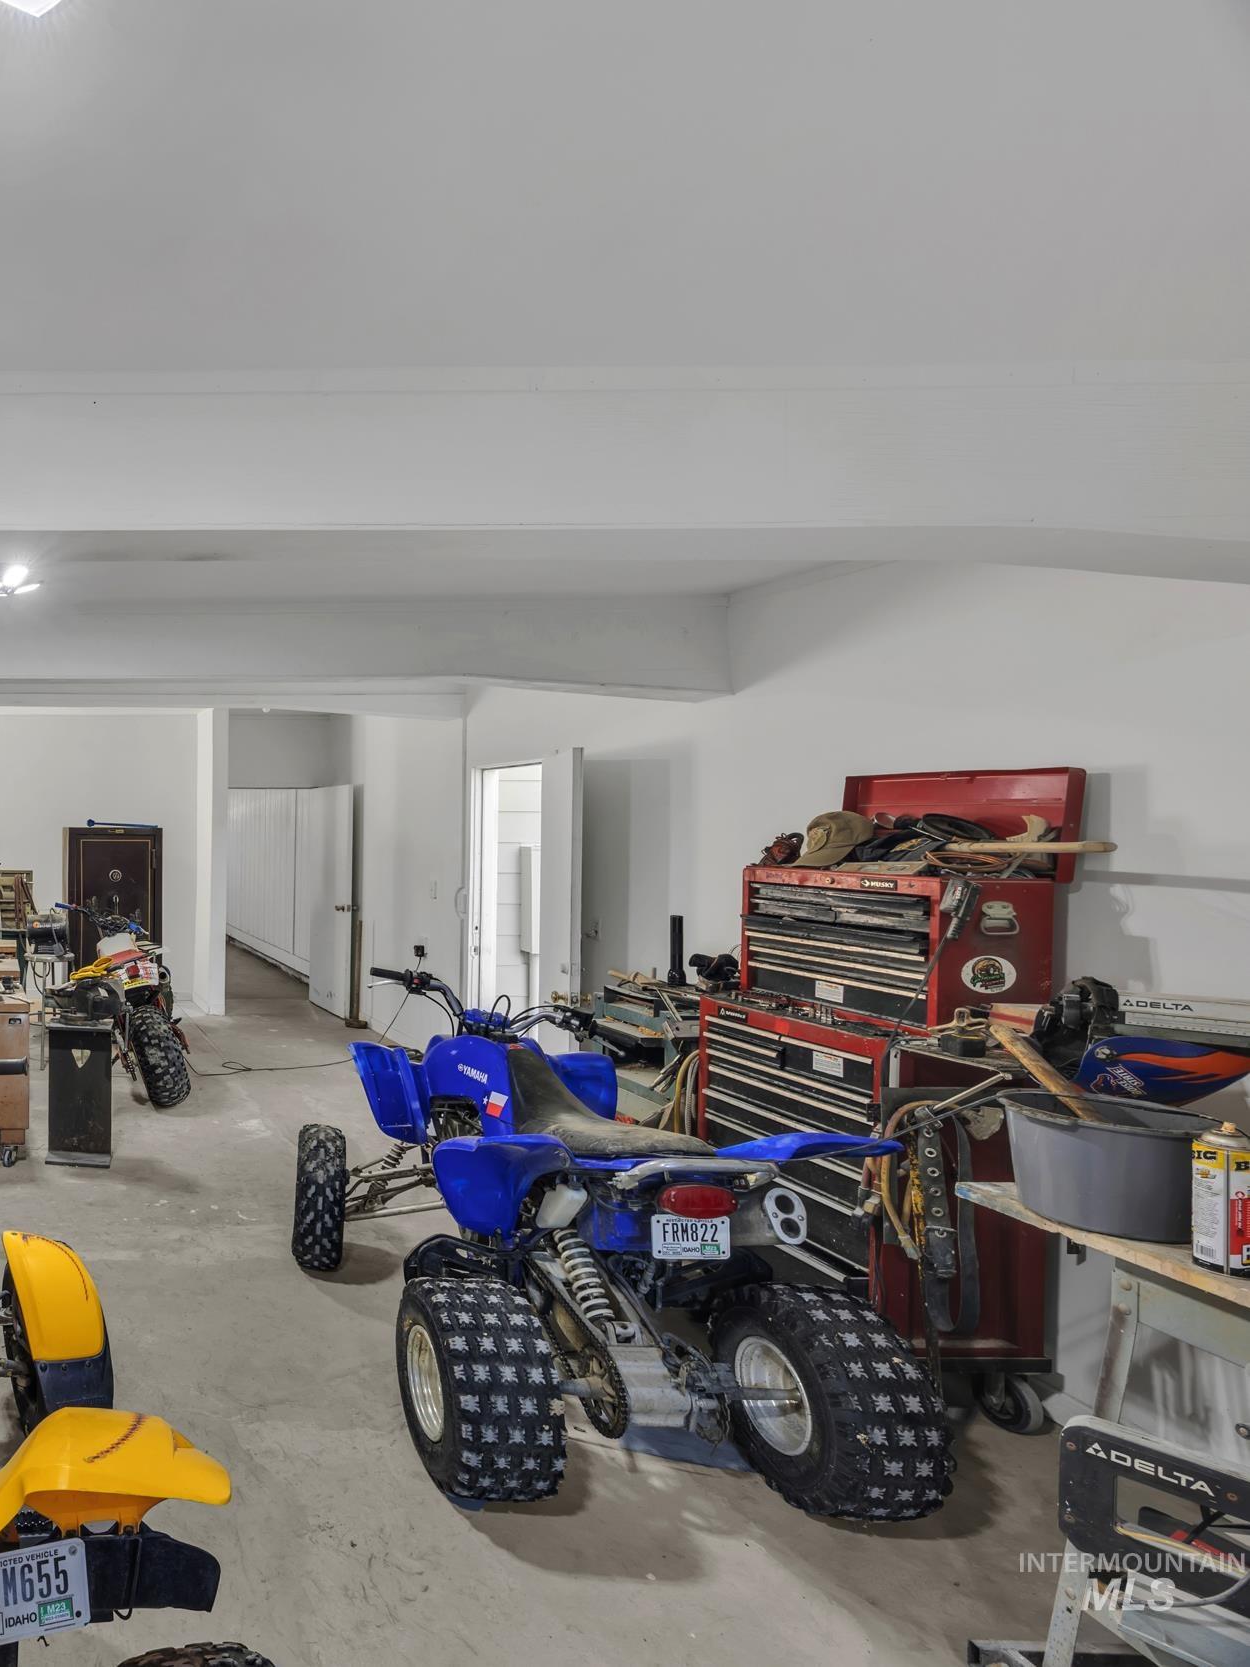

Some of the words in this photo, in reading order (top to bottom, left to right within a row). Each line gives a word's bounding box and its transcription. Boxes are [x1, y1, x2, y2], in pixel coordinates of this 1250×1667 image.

[871, 881, 894, 889] HUSKY
[1135, 1000, 1194, 1012] DELTA
[463, 1064, 488, 1084] YAMAHA
[662, 1222, 719, 1243] FRM822
[1110, 1450, 1215, 1498] DELTA
[25, 1548, 59, 1562] VEHICLE
[5, 1611, 38, 1628] IDAHO
